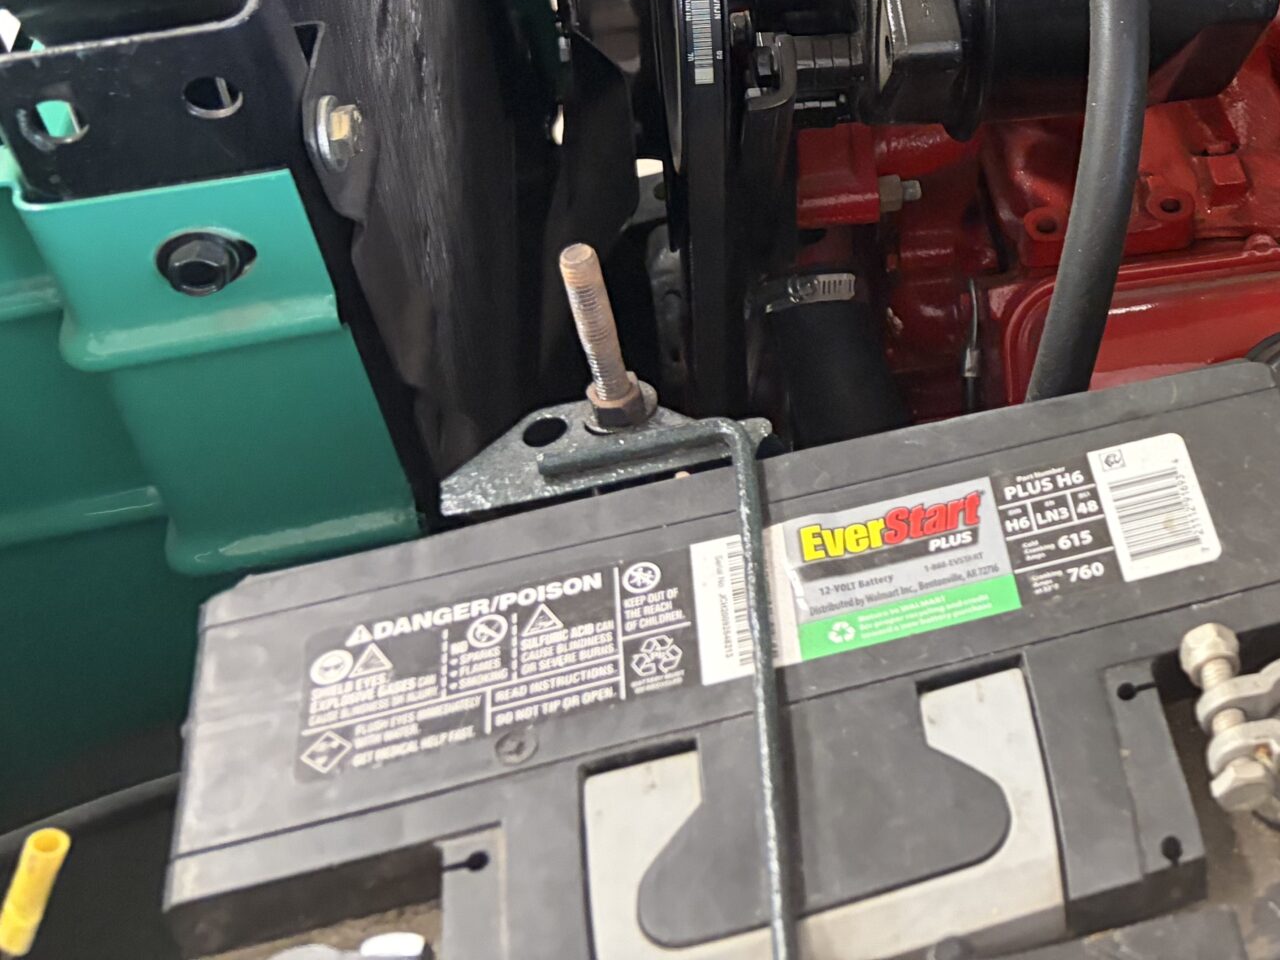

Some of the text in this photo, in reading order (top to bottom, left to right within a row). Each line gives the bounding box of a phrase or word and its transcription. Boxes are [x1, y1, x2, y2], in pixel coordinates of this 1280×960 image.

[1003, 470, 1084, 500] PLUS H6
[1035, 507, 1069, 524] LN3
[1075, 499, 1099, 515] 48
[796, 490, 985, 562] EverStart
[1004, 516, 1030, 532] H6
[927, 531, 973, 552] PLUS
[1056, 529, 1093, 550] 615
[857, 573, 894, 589] Battery
[1066, 560, 1105, 582] 760
[373, 572, 600, 640] DANGER/POISON
[624, 587, 678, 609] KEEP OUT OF
[625, 600, 671, 620] THE REACH
[625, 620, 637, 631] OF
[495, 684, 528, 702] READ
[514, 705, 538, 721] NOT
